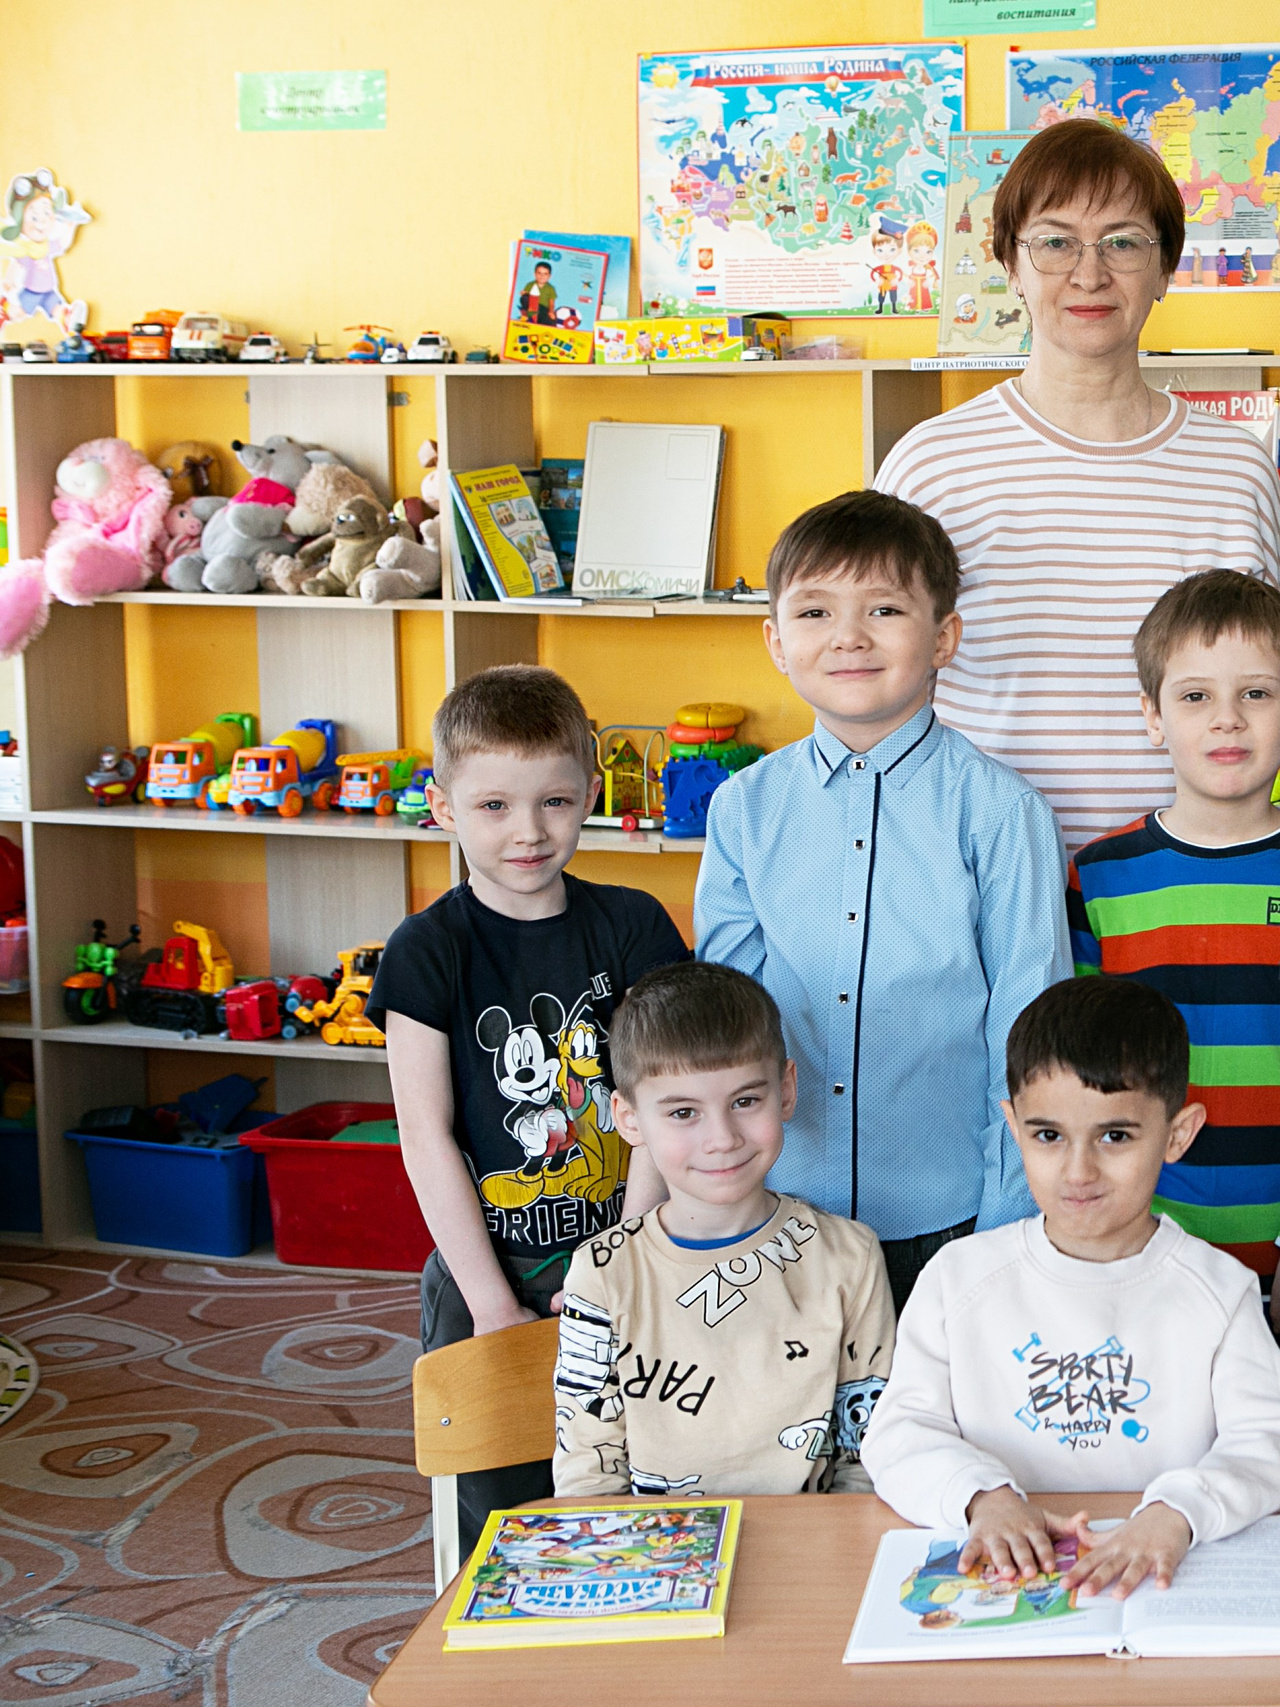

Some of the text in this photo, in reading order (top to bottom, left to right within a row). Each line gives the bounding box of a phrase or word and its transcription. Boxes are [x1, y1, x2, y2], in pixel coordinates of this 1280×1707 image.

[997, 8, 1076, 20] воспитания
[774, 62, 819, 76] наша
[823, 56, 886, 77] Родина
[1090, 52, 1242, 67] РОССИЙСКАЯ ФЕДЕРАЦИЯ
[913, 360, 1029, 370] ЦЕНТР ПАТРИОТИЧЕСКОГО
[1188, 400, 1227, 416] ИКАЯ
[676, 1216, 818, 1329] ZONE
[1028, 1351, 1133, 1387] SPORTY
[1028, 1381, 1136, 1416] BEAR
[1060, 1419, 1111, 1435] HAPPY
[1067, 1436, 1101, 1452] YOU
[524, 1579, 662, 1600] РАССКАЗЫ
